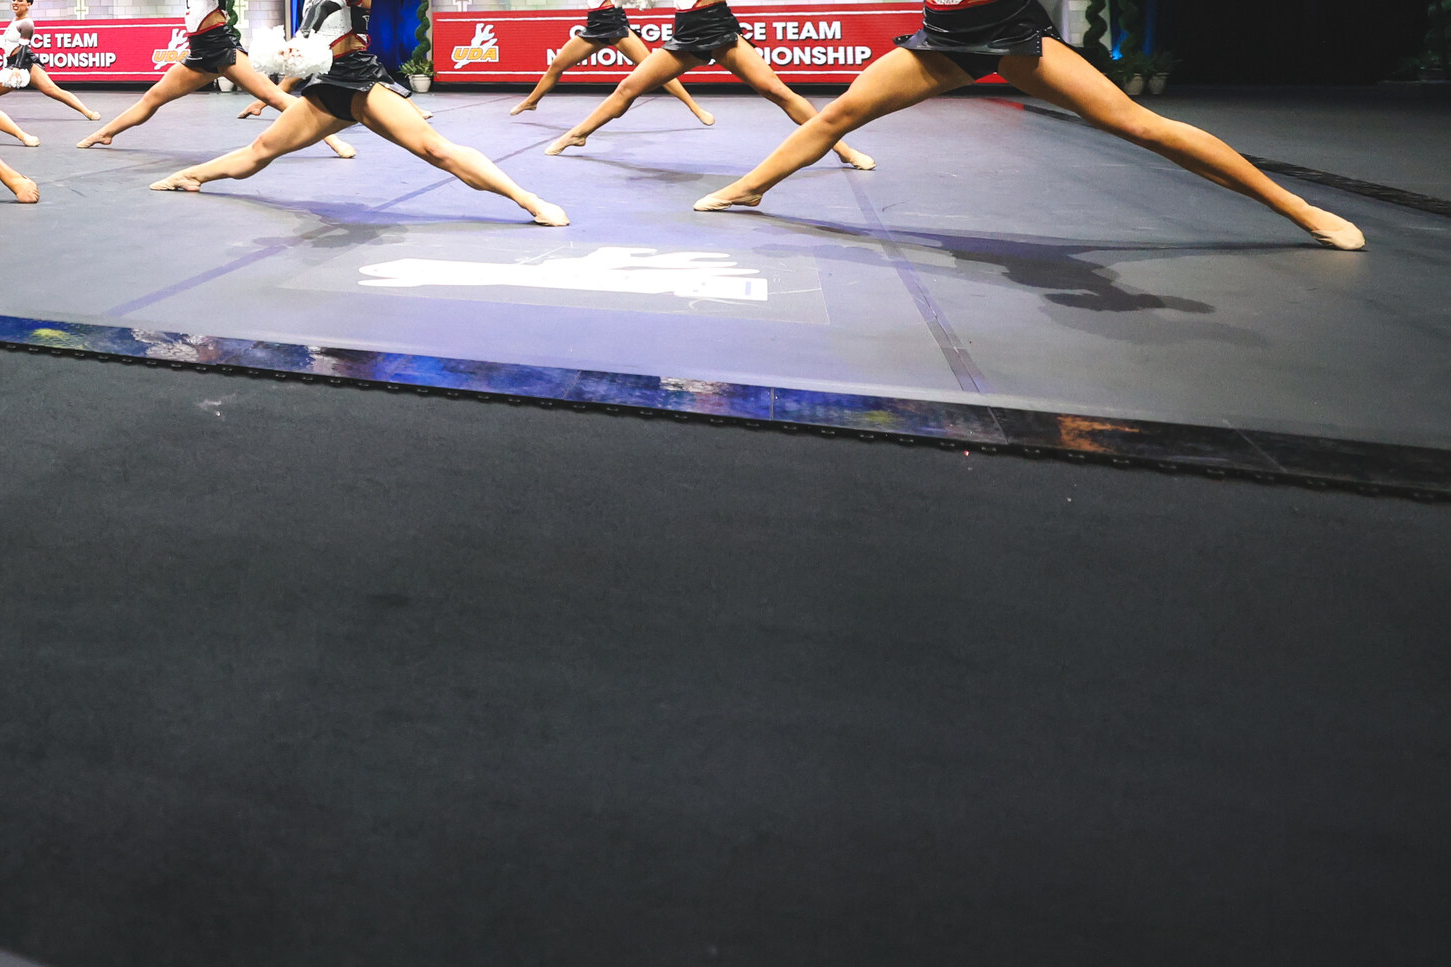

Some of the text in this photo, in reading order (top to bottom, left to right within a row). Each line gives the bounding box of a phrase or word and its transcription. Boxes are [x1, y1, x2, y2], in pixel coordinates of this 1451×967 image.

[772, 20, 842, 40] TEAM
[55, 32, 98, 48] TEAM
[453, 47, 497, 60] UDA
